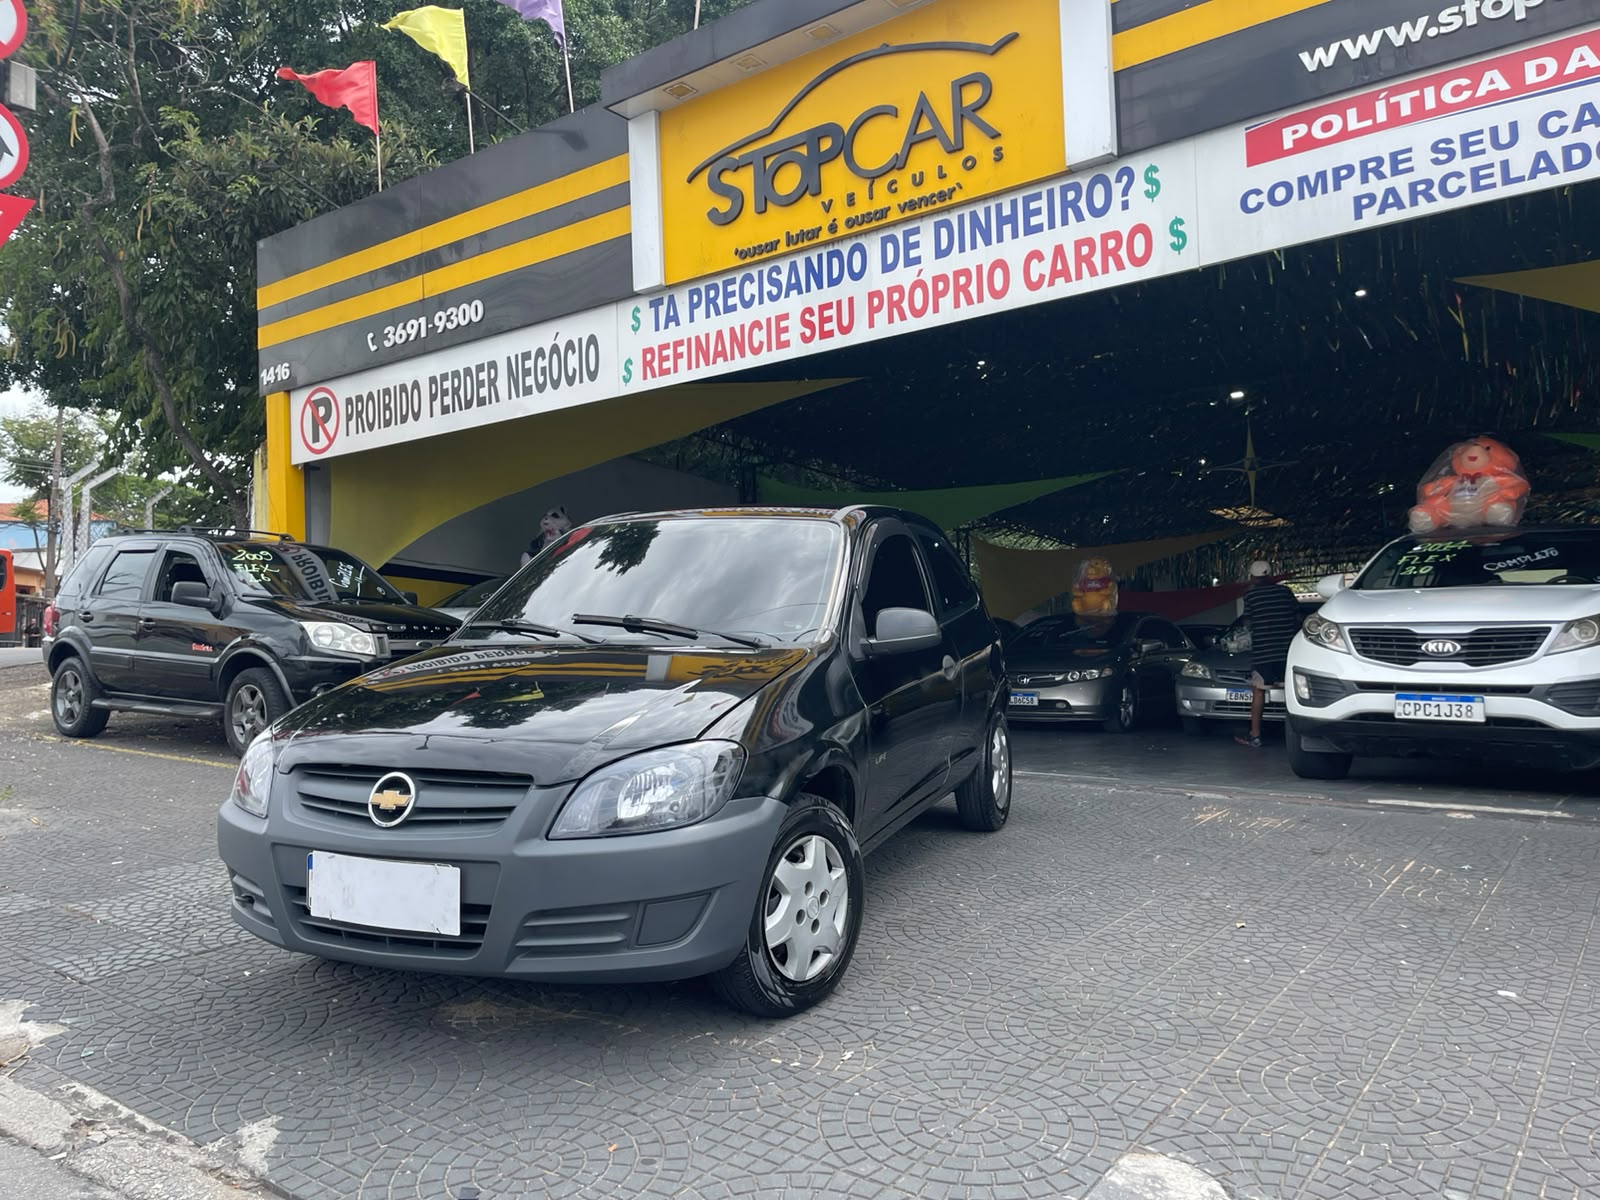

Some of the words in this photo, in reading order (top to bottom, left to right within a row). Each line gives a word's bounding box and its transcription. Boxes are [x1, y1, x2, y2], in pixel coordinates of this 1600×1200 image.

[1282, 69, 1511, 151] POLÍTICA
[1524, 45, 1600, 85] DA
[706, 71, 1002, 226] STOPCAR
[821, 146, 1004, 214] VEÍCULOS
[1240, 147, 1414, 214] COMPRE
[1430, 120, 1519, 166] SEU
[1353, 142, 1600, 221] PARCELAD
[649, 294, 681, 332] TA
[688, 242, 868, 323] PRECISANDO
[880, 226, 922, 274] DE
[934, 166, 1135, 260] DINHEIRO?
[785, 225, 822, 247] lutar
[828, 218, 838, 233] é
[844, 206, 890, 229] ousar
[383, 299, 484, 348] 3691-9300
[642, 312, 791, 381] REFINANCIE
[800, 296, 855, 344] SEU
[867, 258, 1010, 329] PRÓPRIO
[1023, 223, 1153, 292] CARRO
[260, 362, 291, 386] 1416
[345, 379, 422, 437] PROIBIDO
[428, 360, 500, 418] PERDER
[506, 331, 600, 401] NEGÓCIO
[232, 549, 273, 561] 2009
[1397, 553, 1456, 565] FLEX
[1427, 642, 1454, 653] KIA
[1402, 702, 1474, 719] CPC1J38
